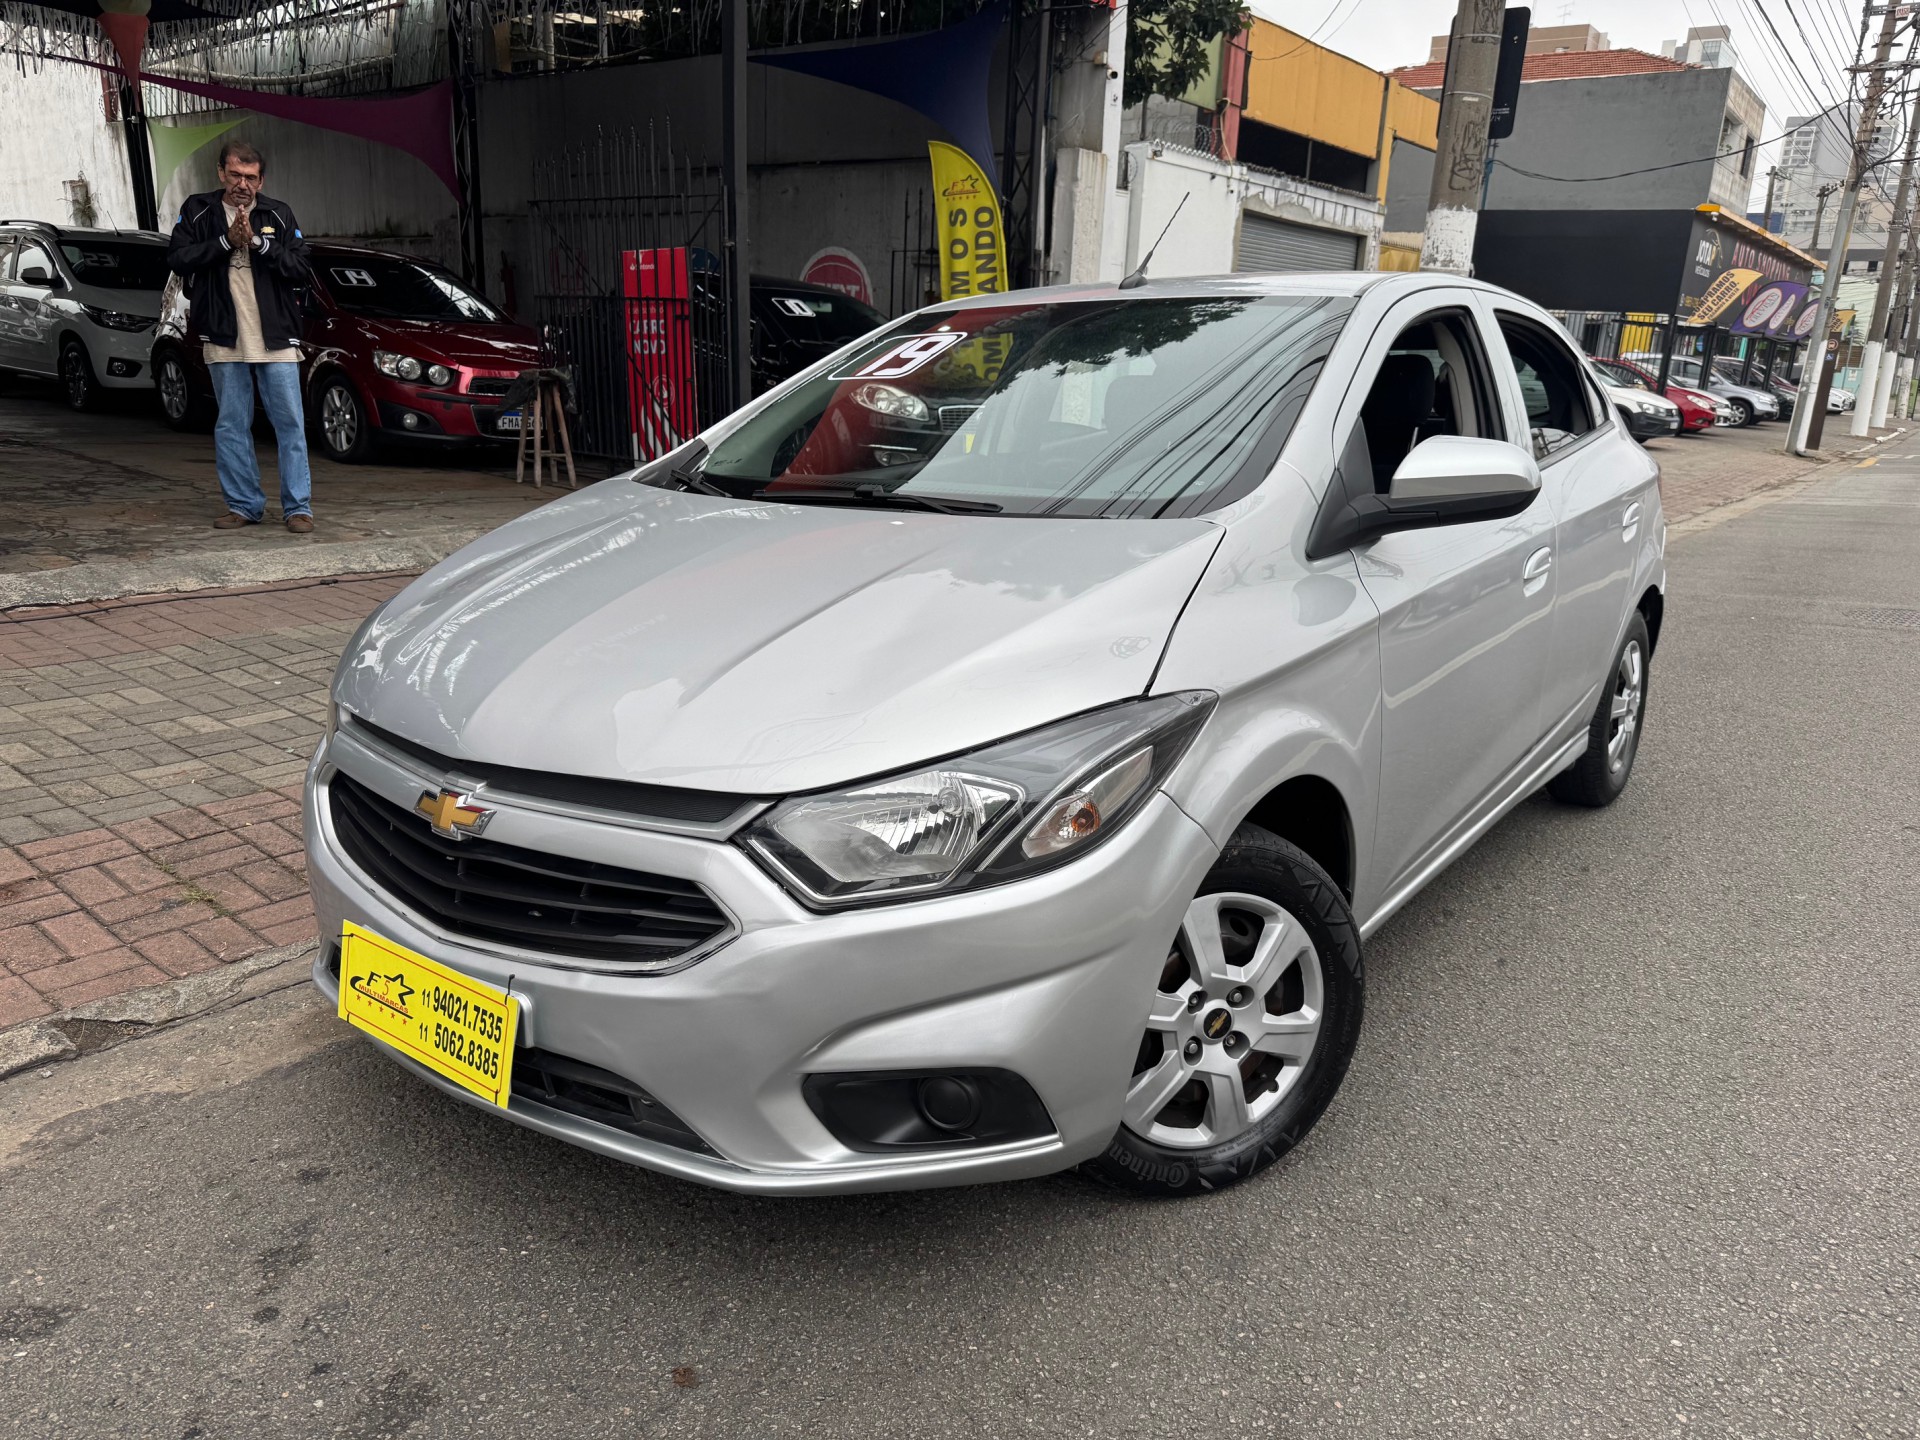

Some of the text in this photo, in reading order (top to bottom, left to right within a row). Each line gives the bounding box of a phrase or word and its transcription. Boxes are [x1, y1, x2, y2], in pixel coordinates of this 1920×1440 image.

[344, 270, 373, 286] 14
[1731, 240, 1791, 281] AUTO SHOPPING
[784, 299, 814, 317] 10
[1697, 302, 1714, 320] SEU
[855, 335, 958, 376] 19
[359, 984, 409, 1014] MULTIMARCAS
[422, 986, 503, 1043] 11 94021.7535
[419, 1022, 499, 1079] 11 5062.8385
